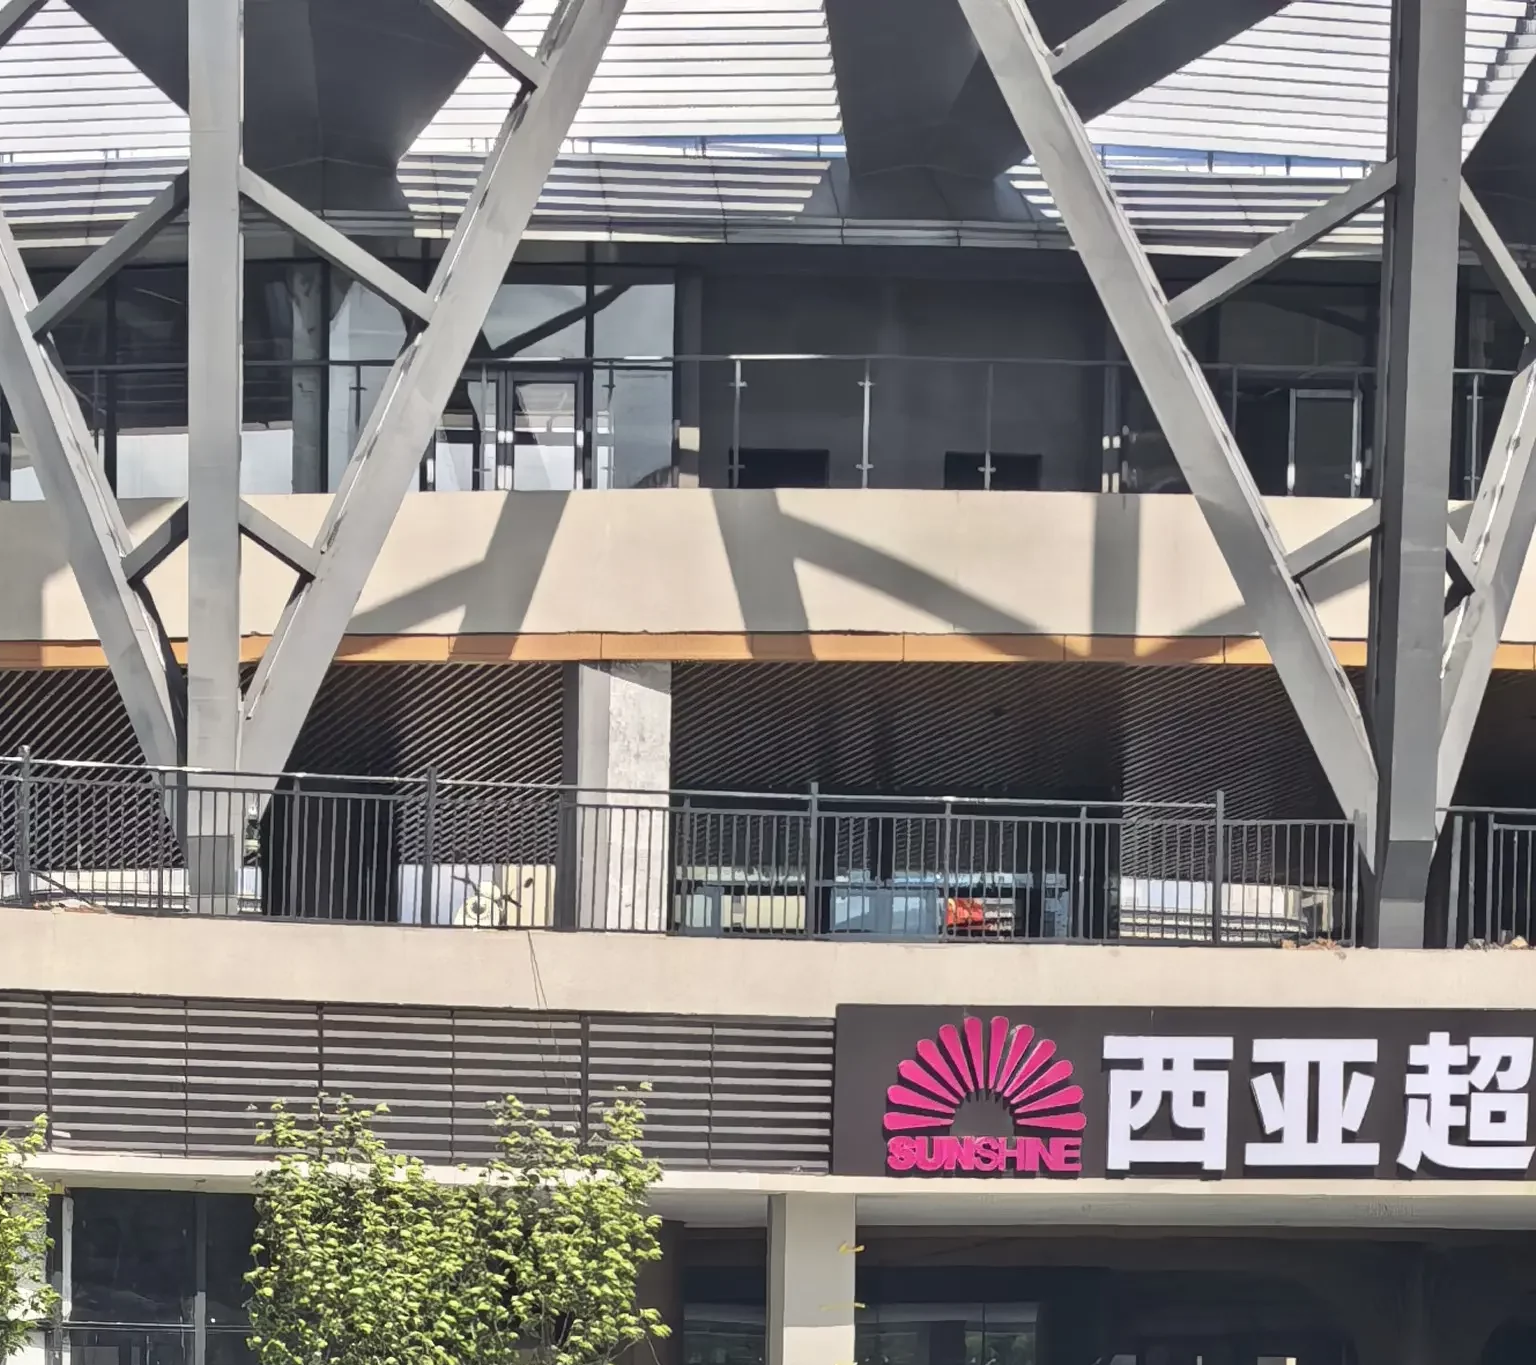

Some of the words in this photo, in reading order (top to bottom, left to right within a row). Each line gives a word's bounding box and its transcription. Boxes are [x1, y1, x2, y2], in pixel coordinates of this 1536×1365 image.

[1102, 1031, 1536, 1172] 西亚超
[887, 1136, 1082, 1171] SUNSHINE
